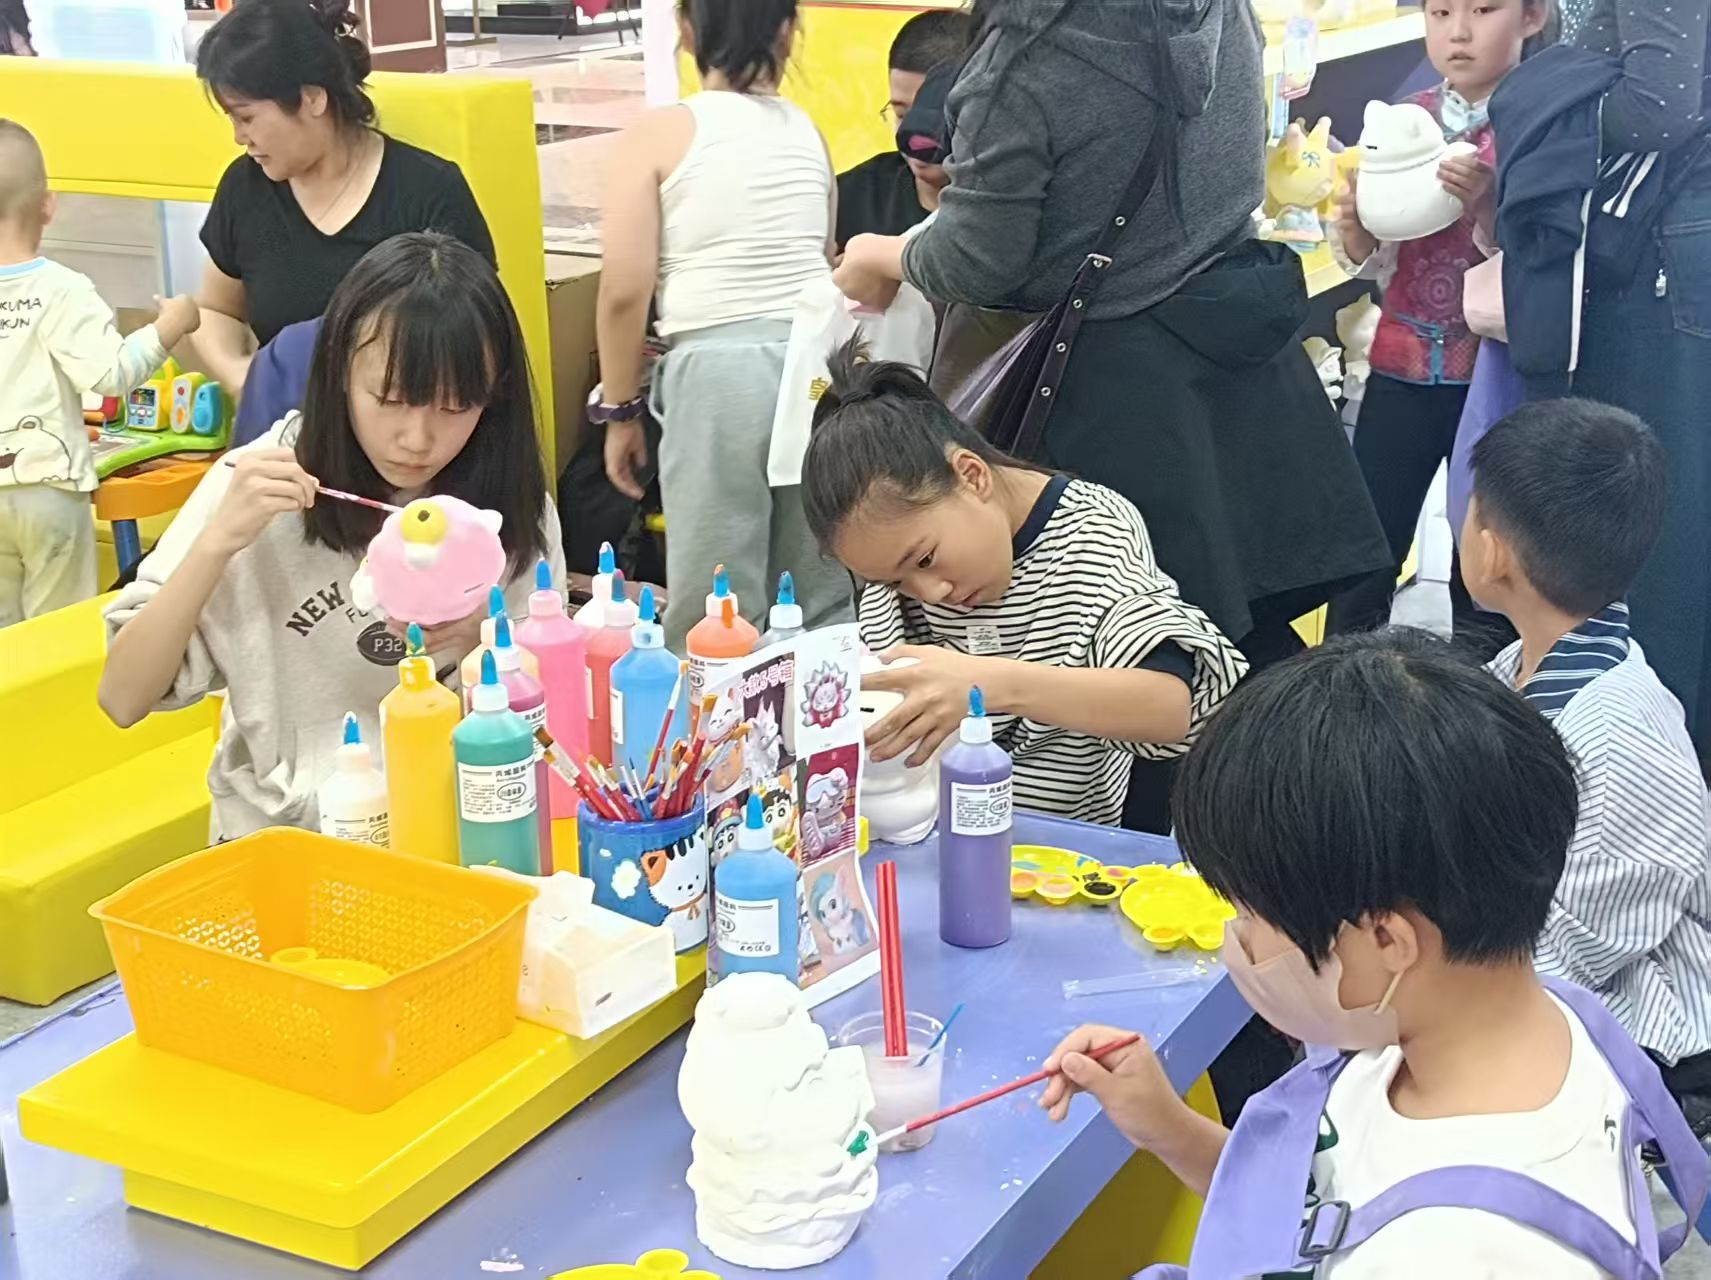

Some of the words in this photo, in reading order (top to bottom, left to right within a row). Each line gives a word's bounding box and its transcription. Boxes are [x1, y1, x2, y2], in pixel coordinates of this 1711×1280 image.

[0, 317, 30, 330] KUN
[286, 581, 345, 636] NEW
[373, 638, 402, 653] P32
